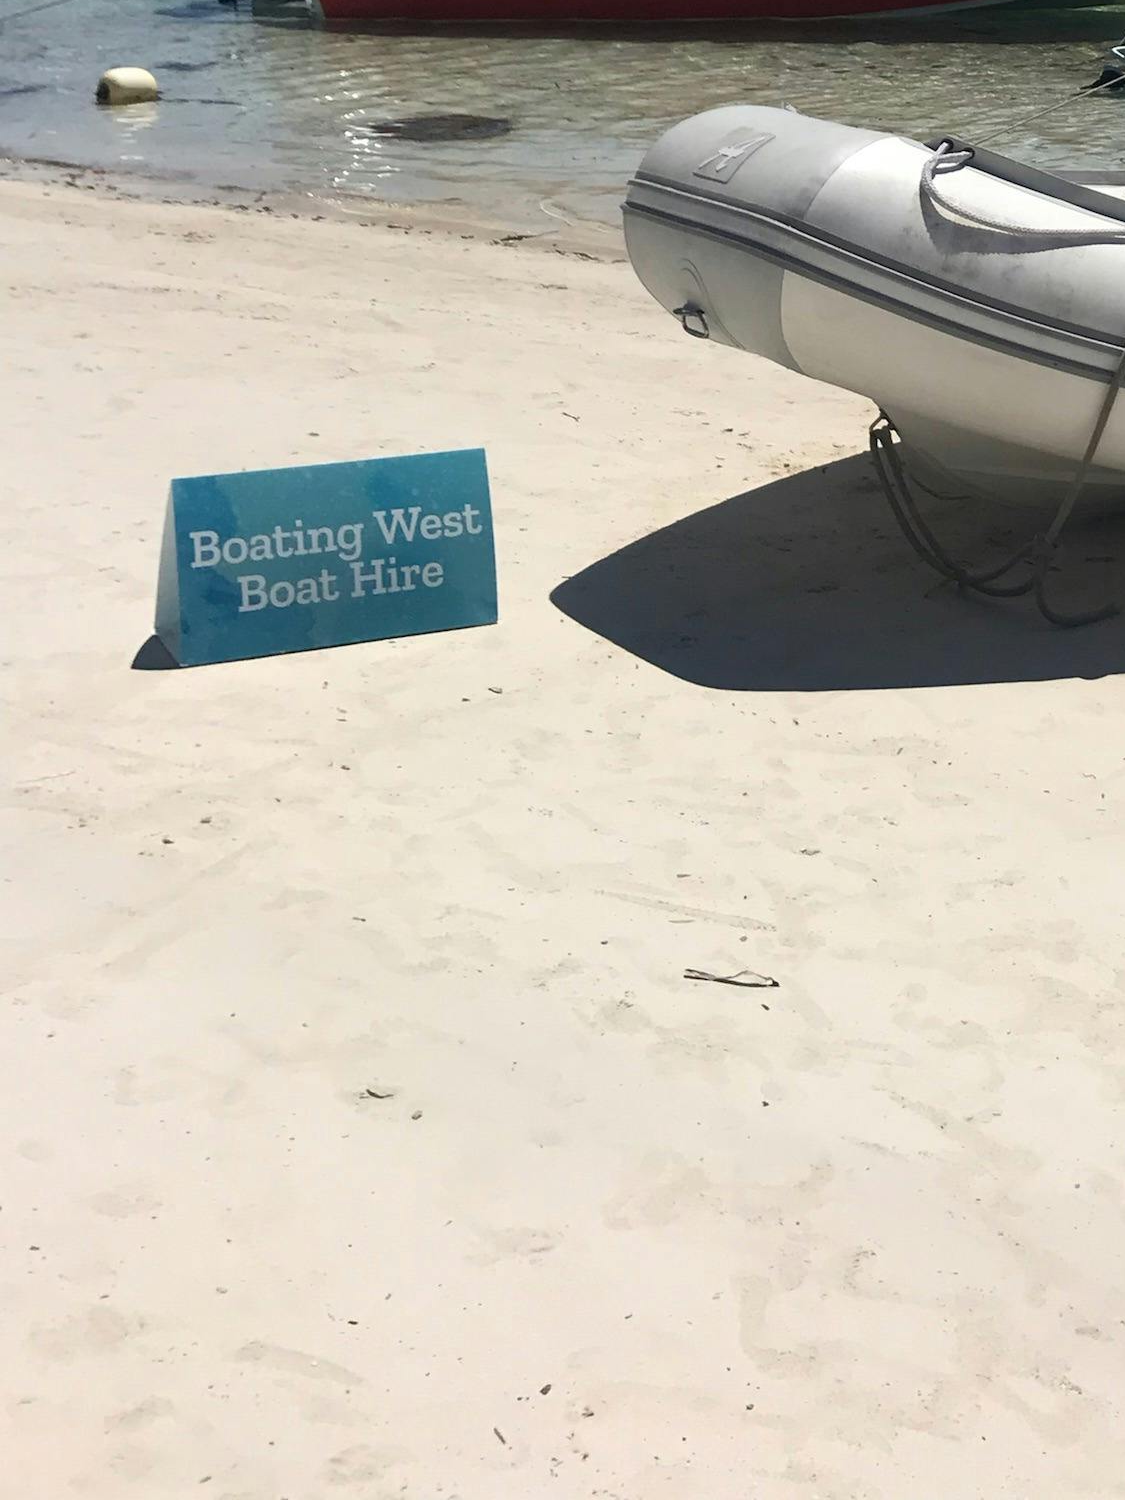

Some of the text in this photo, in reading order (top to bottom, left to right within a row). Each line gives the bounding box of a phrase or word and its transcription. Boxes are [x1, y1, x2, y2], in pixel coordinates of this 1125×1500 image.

[189, 503, 482, 569] Boating West
[237, 556, 445, 613] Boat Hire
